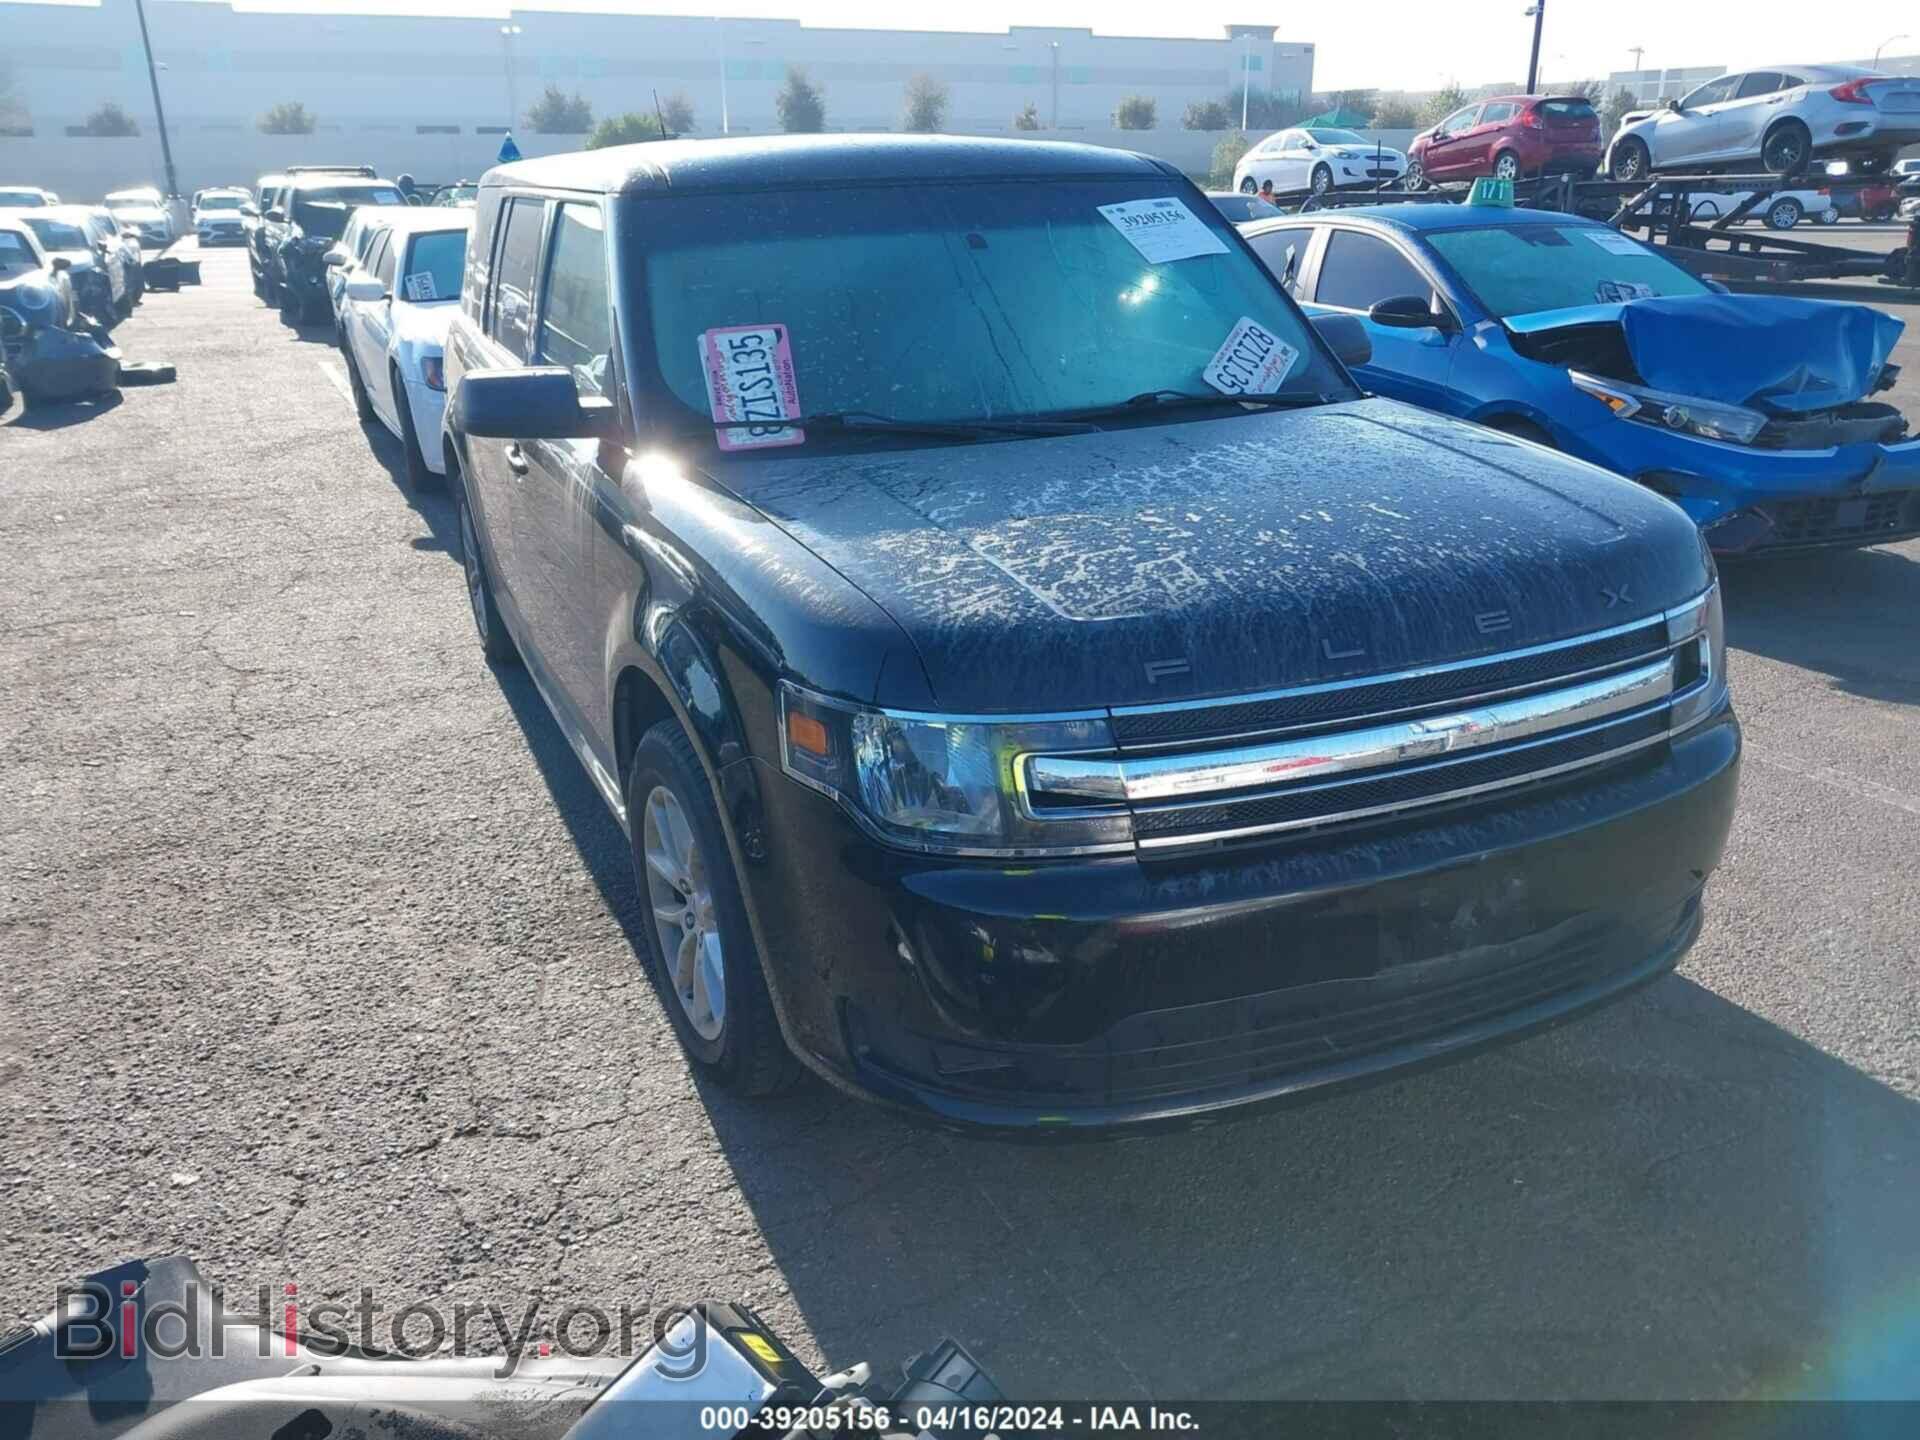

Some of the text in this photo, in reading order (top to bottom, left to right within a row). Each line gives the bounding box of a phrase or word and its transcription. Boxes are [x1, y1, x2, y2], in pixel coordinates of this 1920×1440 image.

[1119, 210, 1186, 228] 39205156
[1481, 180, 1505, 201] 171
[728, 334, 783, 437] 8ZIS135
[1217, 326, 1274, 394] 8ZIS135
[1144, 582, 1633, 685] FLEX
